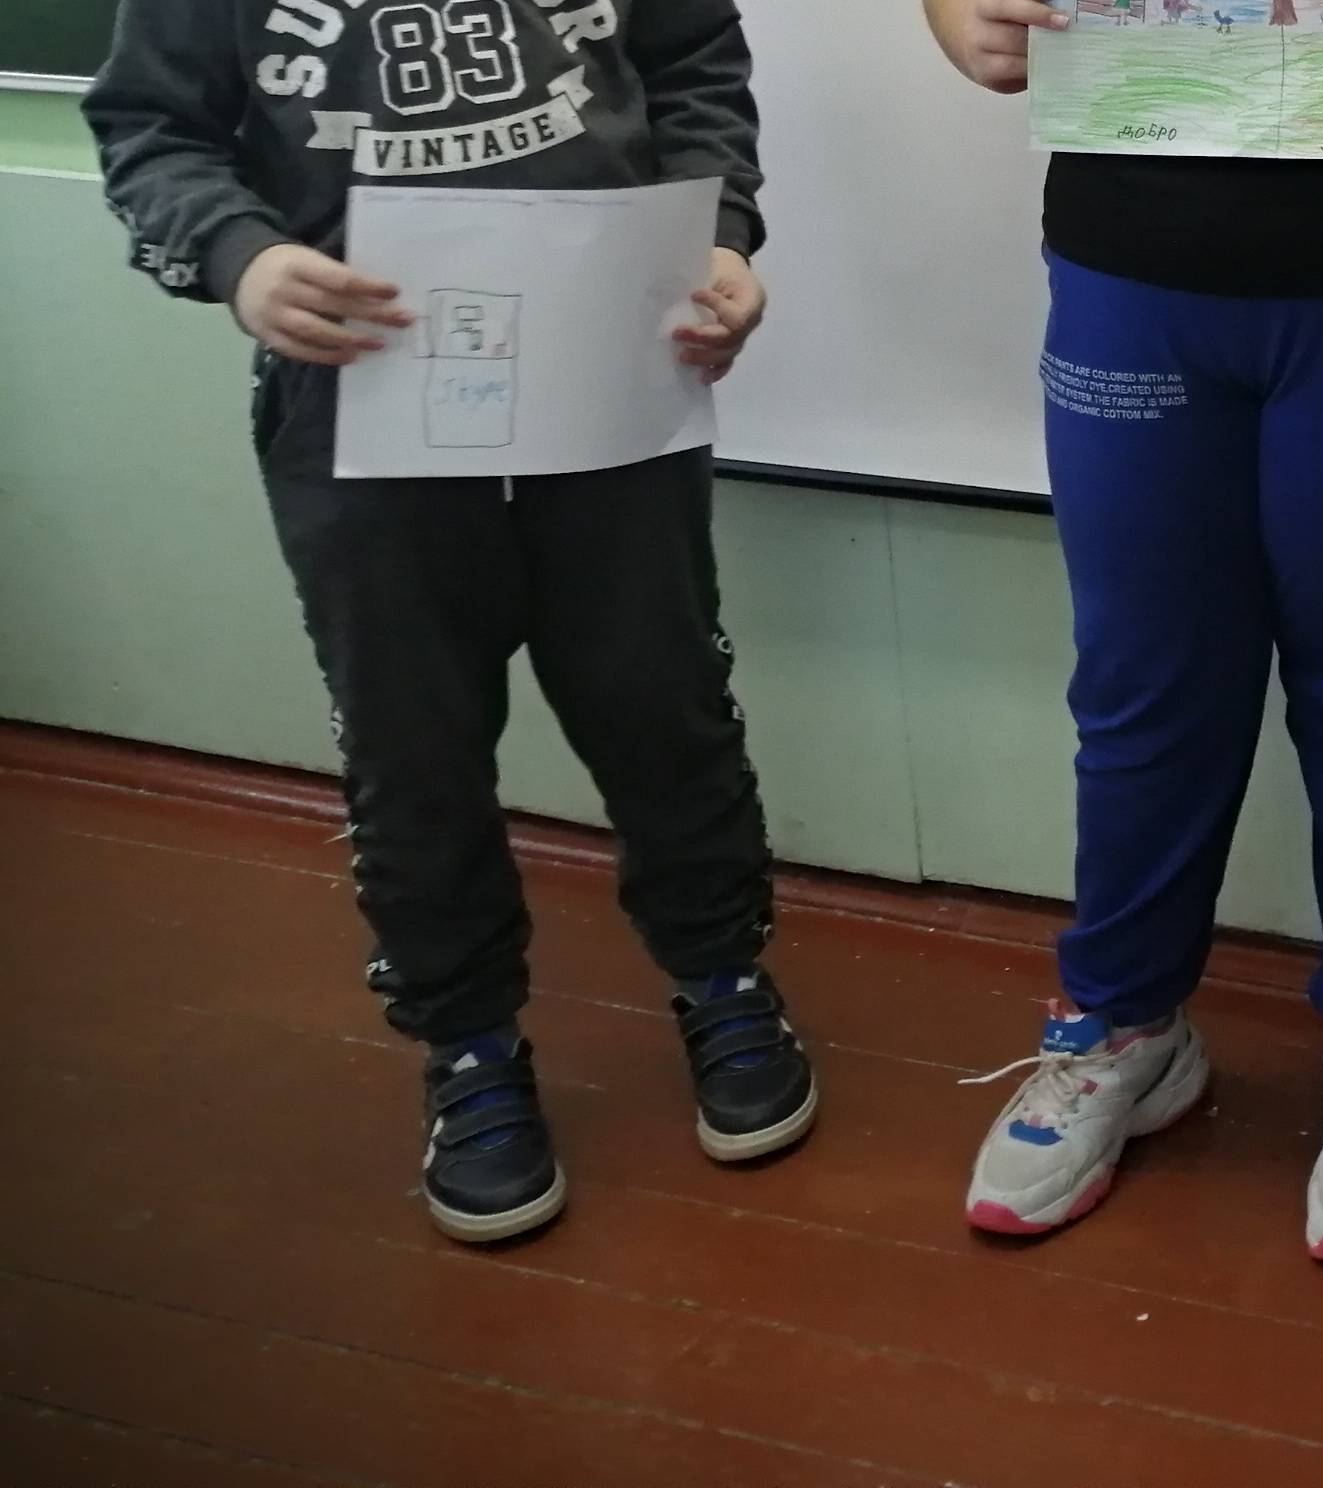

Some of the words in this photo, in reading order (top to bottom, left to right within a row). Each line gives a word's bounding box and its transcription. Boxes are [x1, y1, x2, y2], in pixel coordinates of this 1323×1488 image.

[374, 112, 556, 170] VINTAGE
[1075, 365, 1091, 378] ARE
[1092, 369, 1137, 383] COLORED
[1138, 373, 1165, 383] WITH
[1094, 394, 1111, 407] THE
[1112, 396, 1146, 407] FABRIC
